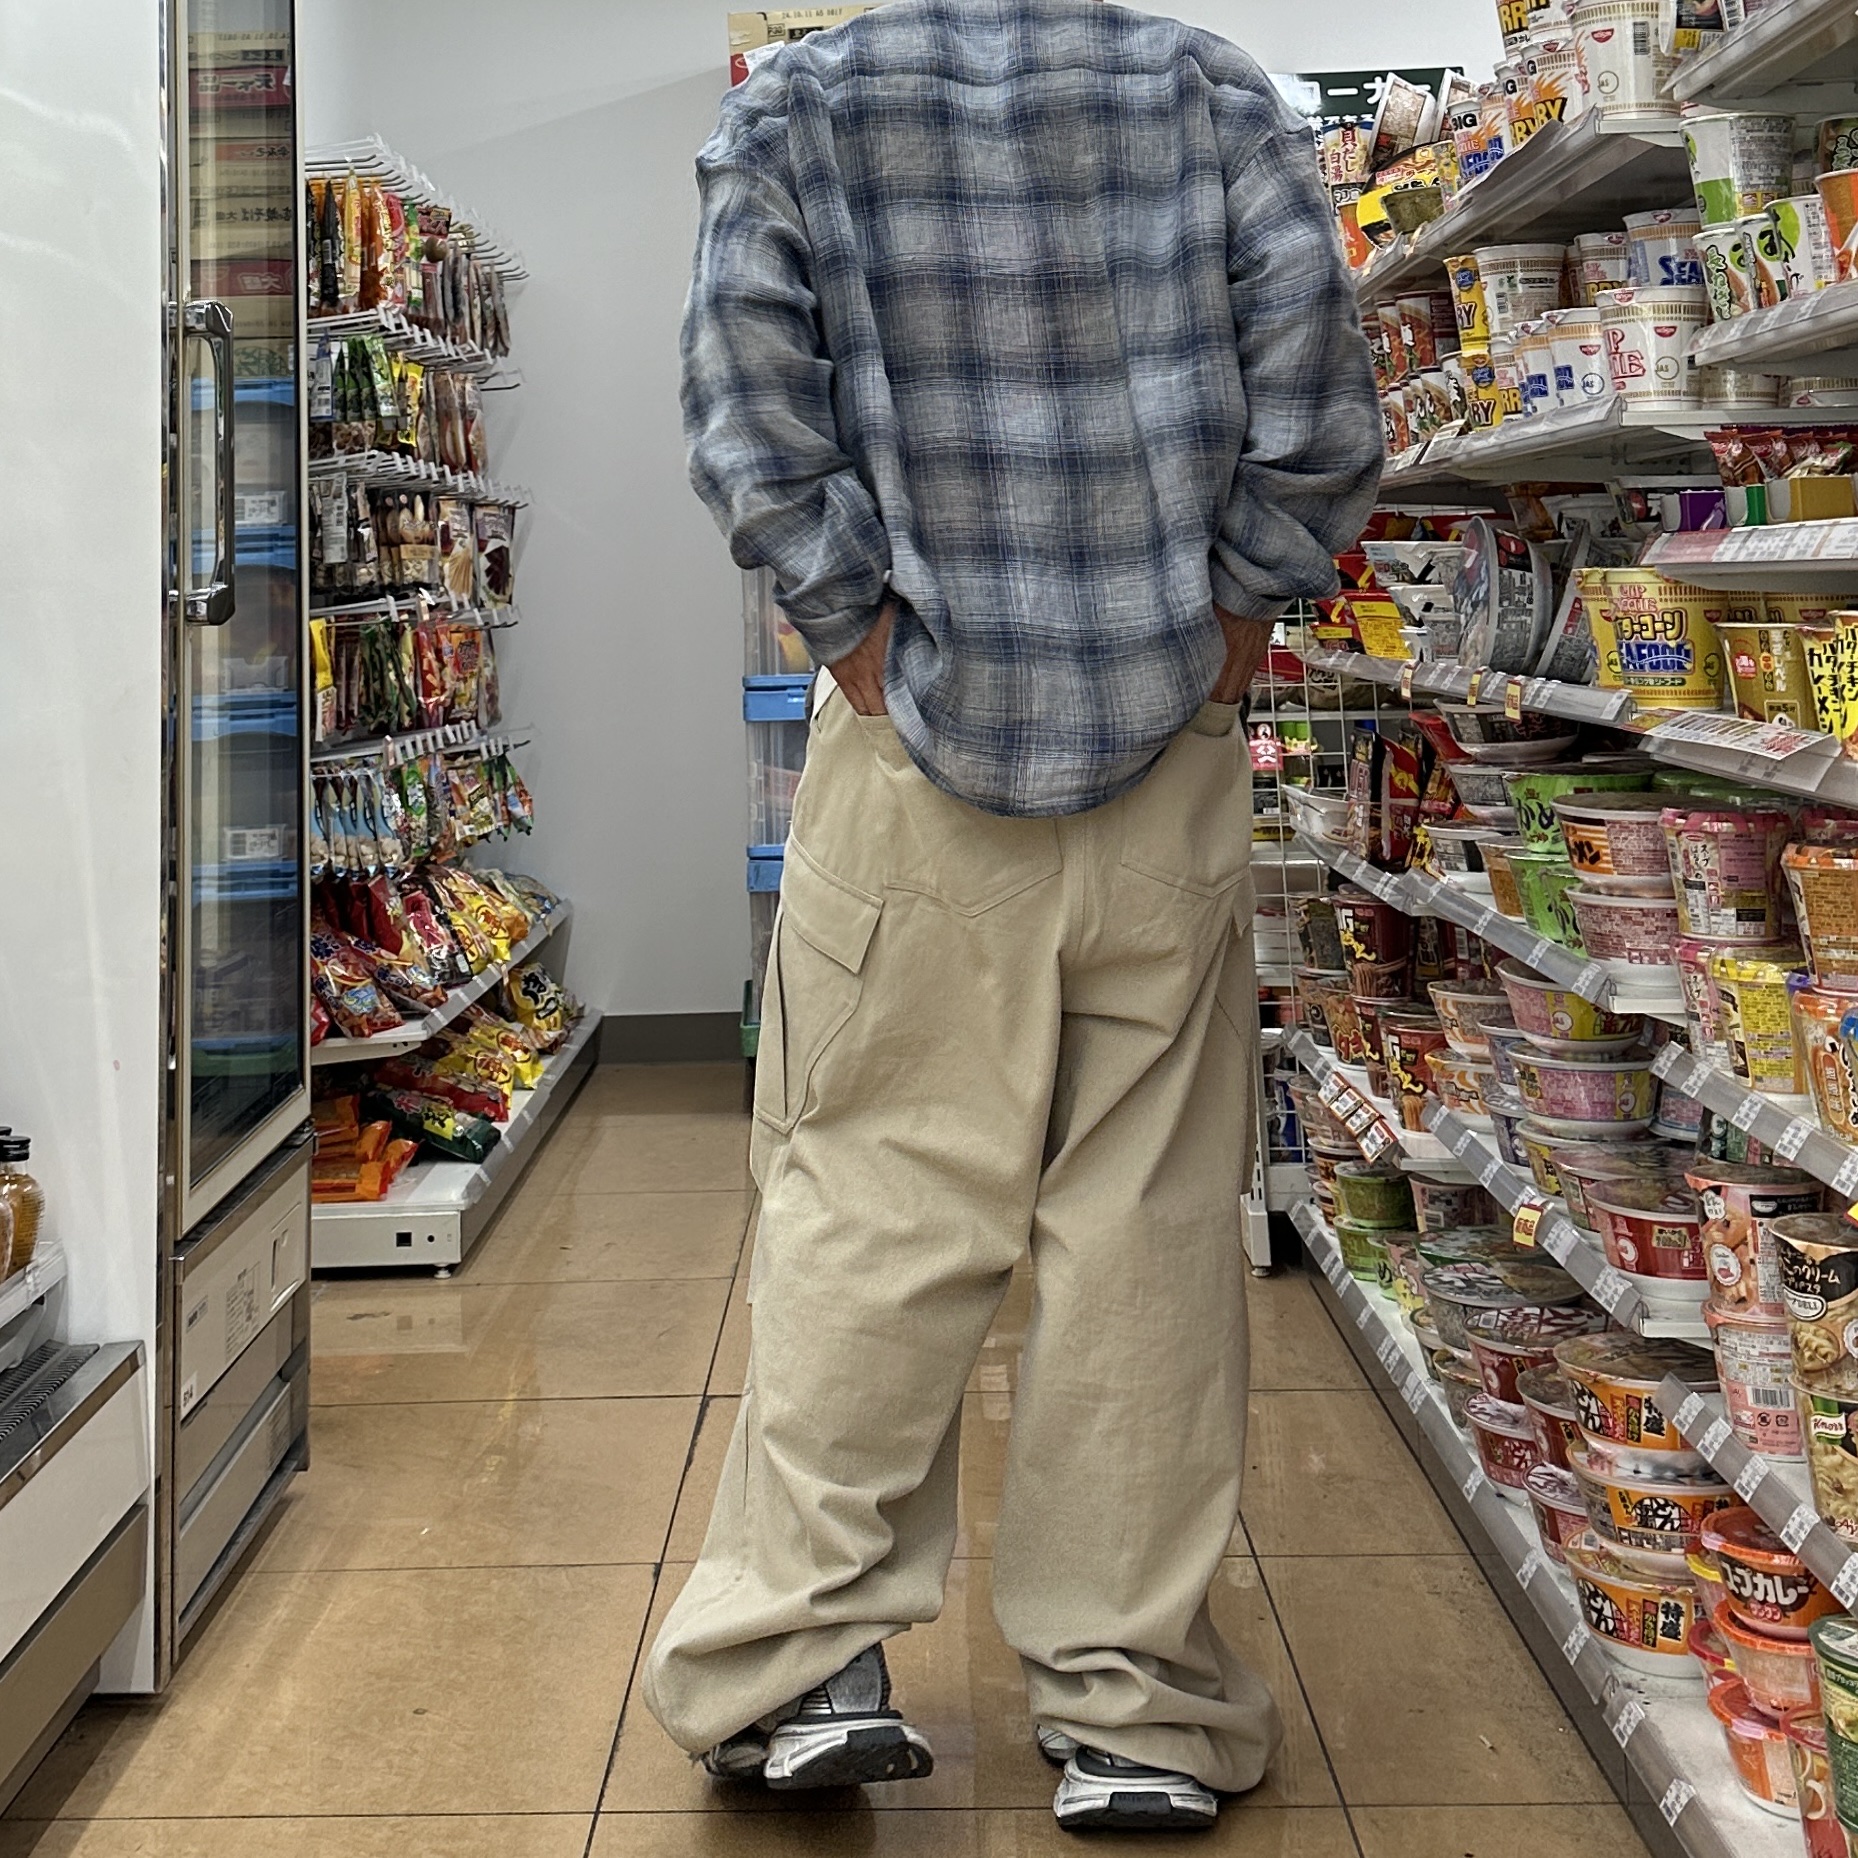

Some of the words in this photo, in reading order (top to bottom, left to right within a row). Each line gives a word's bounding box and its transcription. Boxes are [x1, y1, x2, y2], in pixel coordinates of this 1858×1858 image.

[1659, 255, 1705, 286] SEA
[1617, 610, 1682, 640] ターコーン
[1621, 643, 1692, 671] AFOOD
[1813, 1417, 1845, 1431] Knorr
[1660, 1601, 1685, 1641] 特盛
